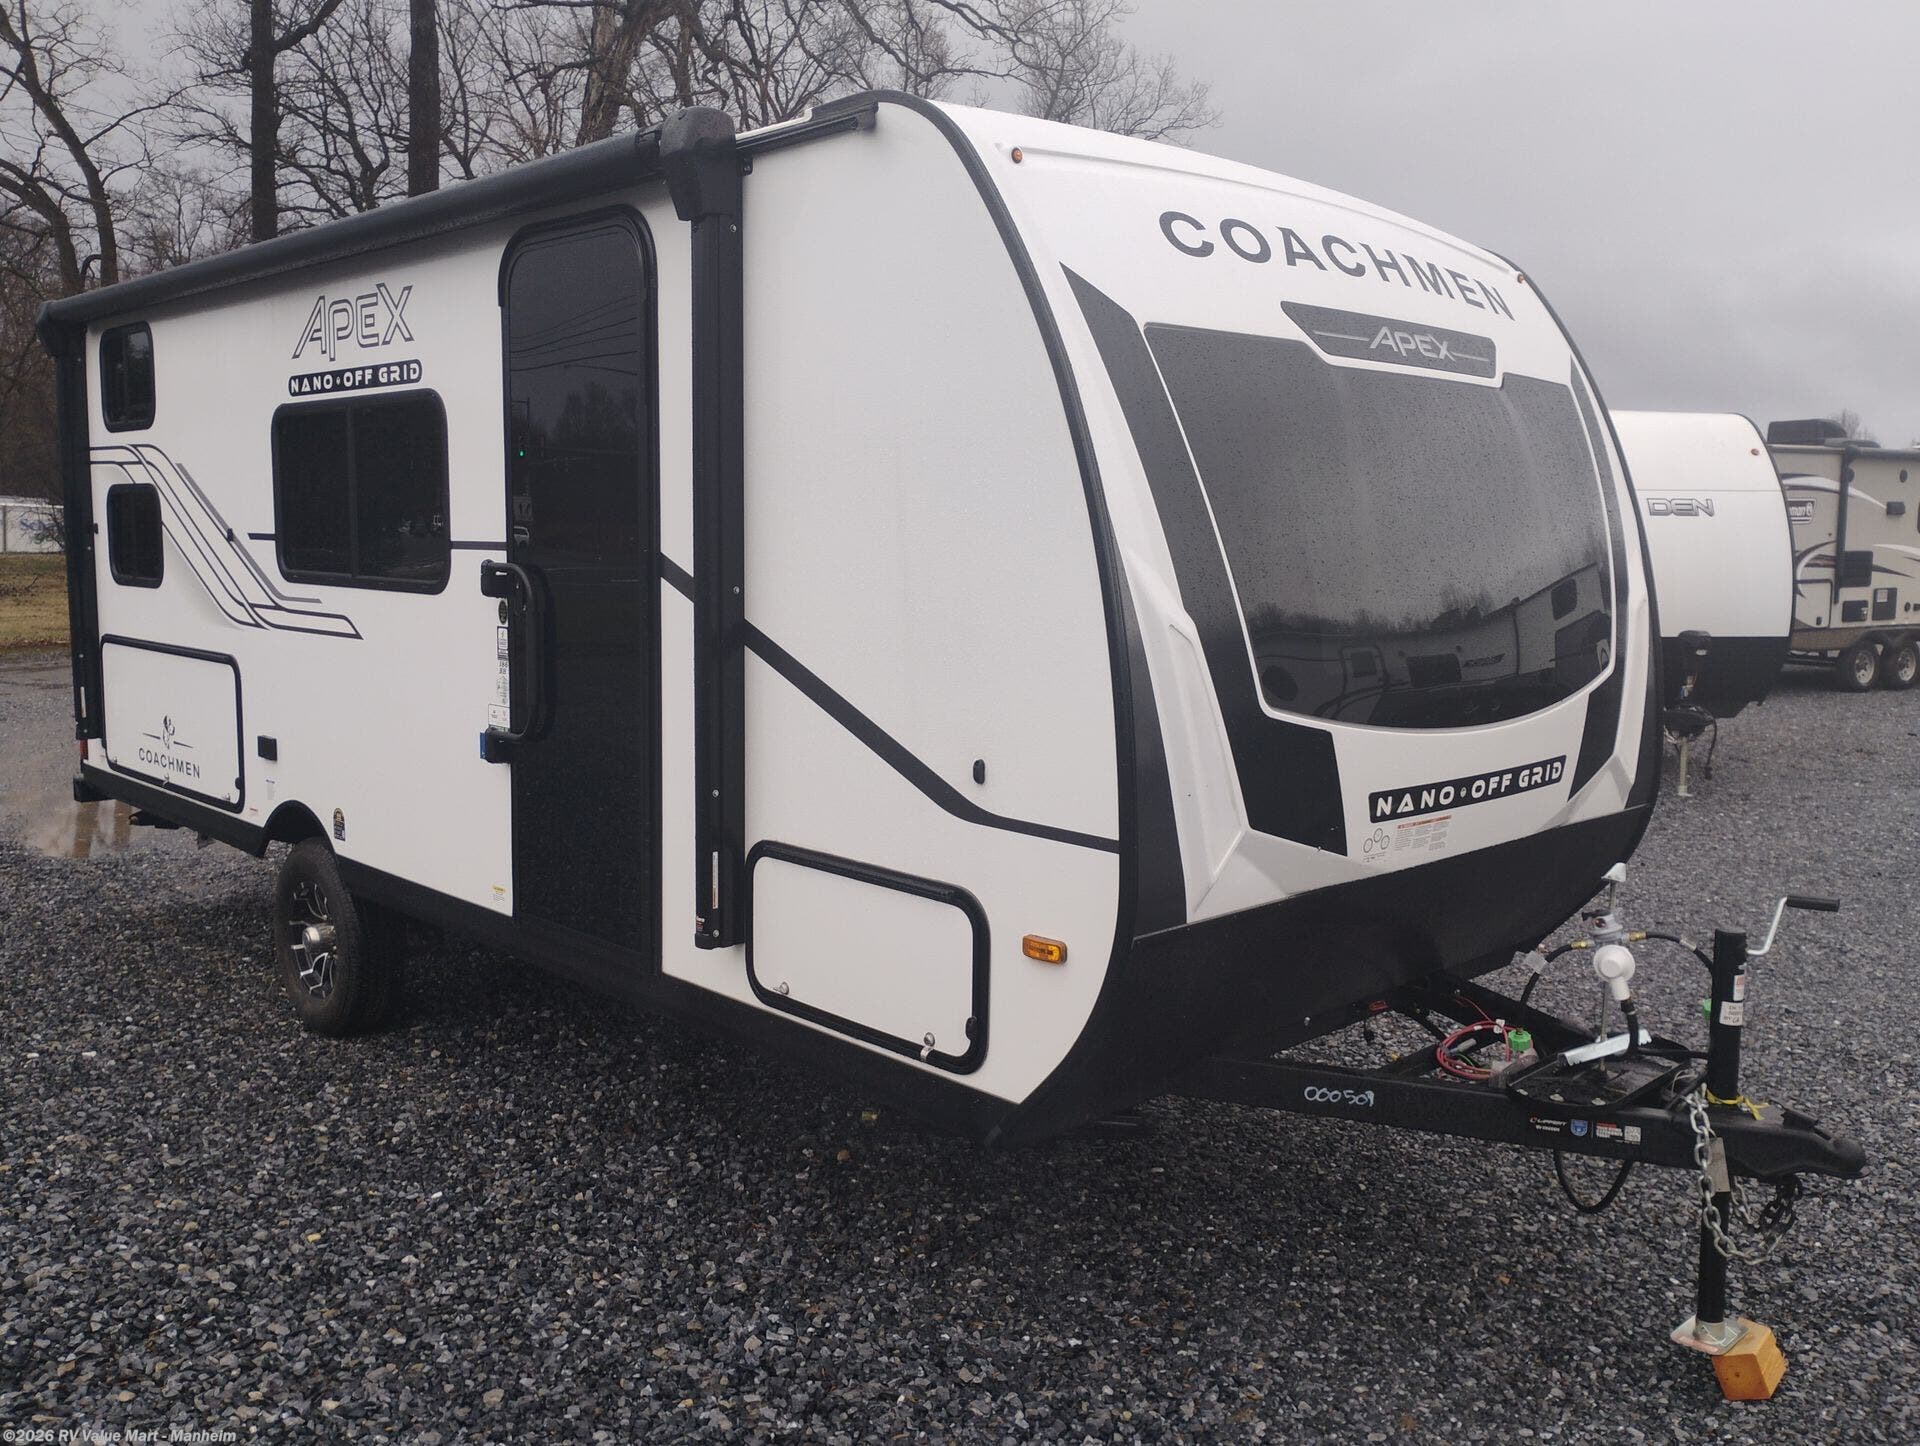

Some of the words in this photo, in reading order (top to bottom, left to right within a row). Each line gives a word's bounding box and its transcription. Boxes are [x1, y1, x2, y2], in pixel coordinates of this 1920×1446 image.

[1158, 210, 1516, 322] COACHMEN
[291, 282, 415, 362] APEX
[1369, 325, 1457, 363] APEX
[290, 374, 333, 394] NANO
[343, 368, 374, 387] OFF
[378, 363, 420, 383] GRID
[1647, 497, 1715, 517] DEN
[138, 747, 201, 779] COACHMEN
[1376, 785, 1455, 817] NANO
[1471, 773, 1513, 799] OFF
[1518, 761, 1562, 788] GRID
